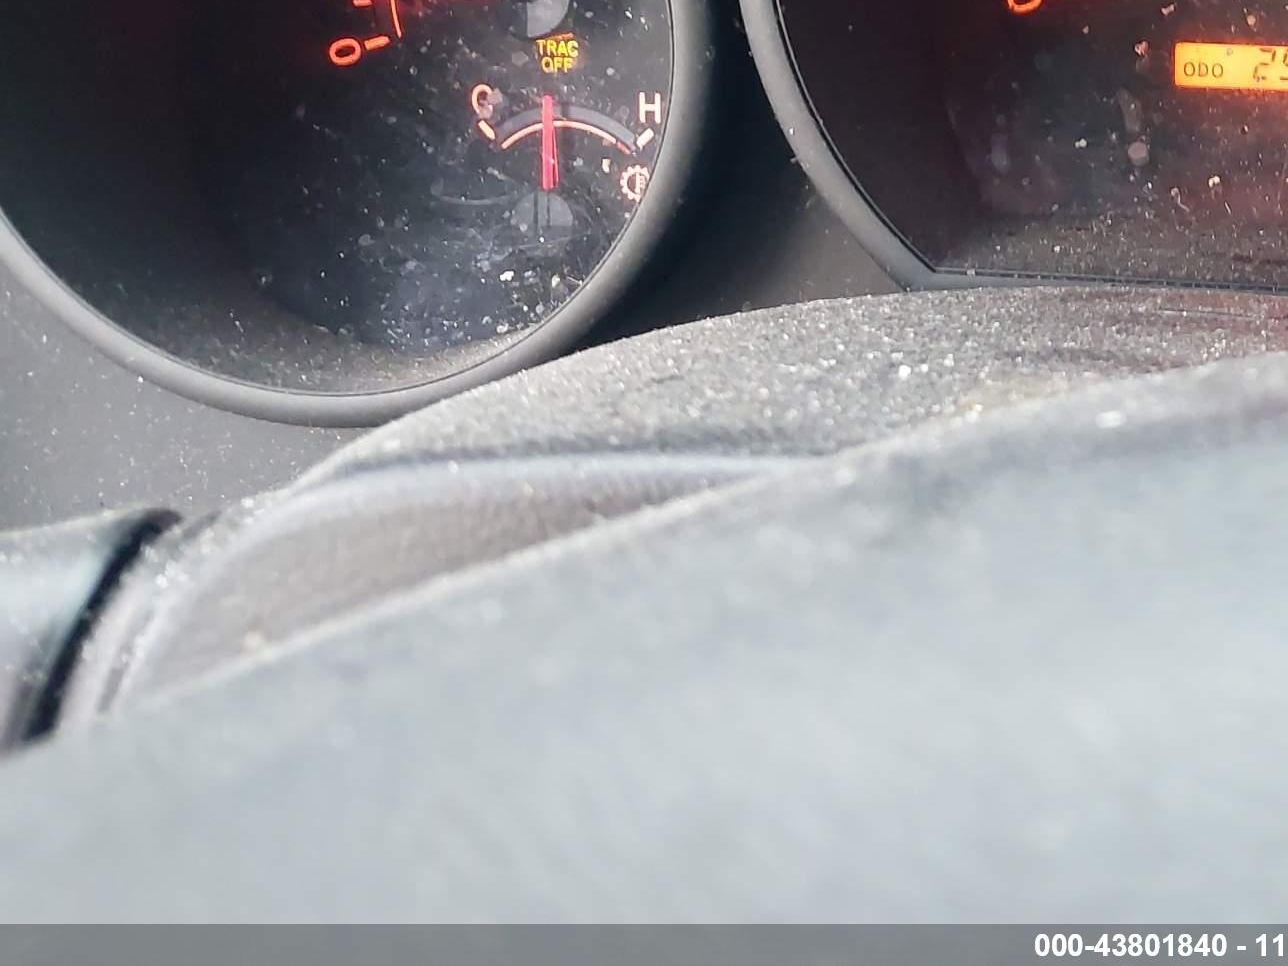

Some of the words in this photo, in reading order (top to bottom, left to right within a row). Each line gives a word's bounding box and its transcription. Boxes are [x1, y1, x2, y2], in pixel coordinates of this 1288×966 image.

[328, 37, 362, 66] 0
[536, 38, 579, 57] TRAC
[541, 56, 574, 73] OFF
[1183, 61, 1224, 79] ODO
[638, 91, 661, 124] H
